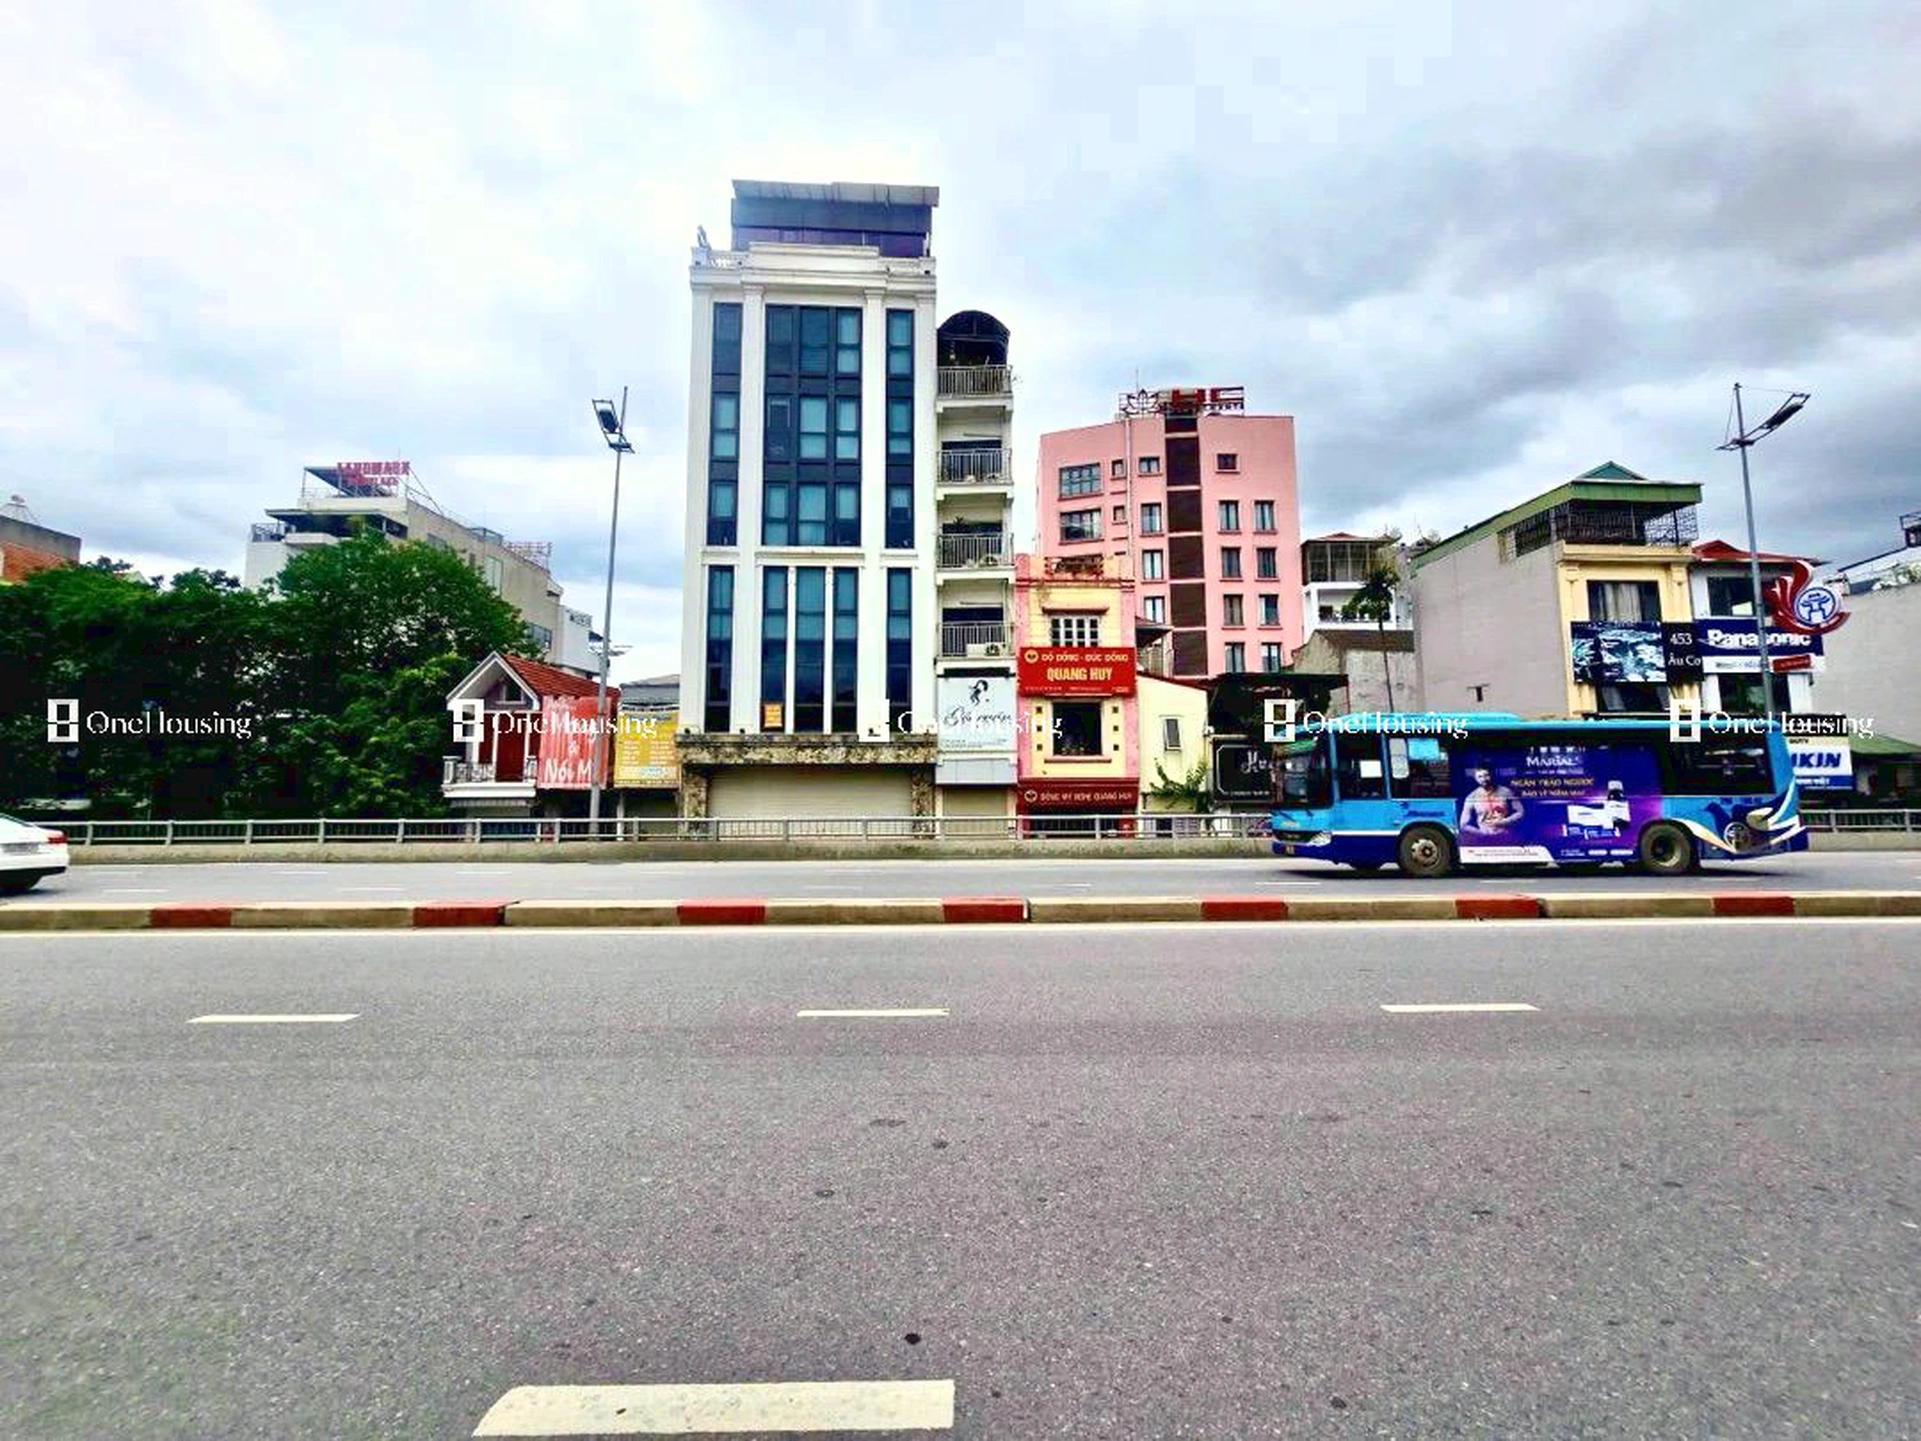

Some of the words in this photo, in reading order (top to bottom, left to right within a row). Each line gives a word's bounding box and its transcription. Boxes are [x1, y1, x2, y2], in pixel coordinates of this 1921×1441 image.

[1670, 632, 1693, 645] 453
[1047, 667, 1087, 682] QUANG
[1089, 667, 1112, 681] HUY
